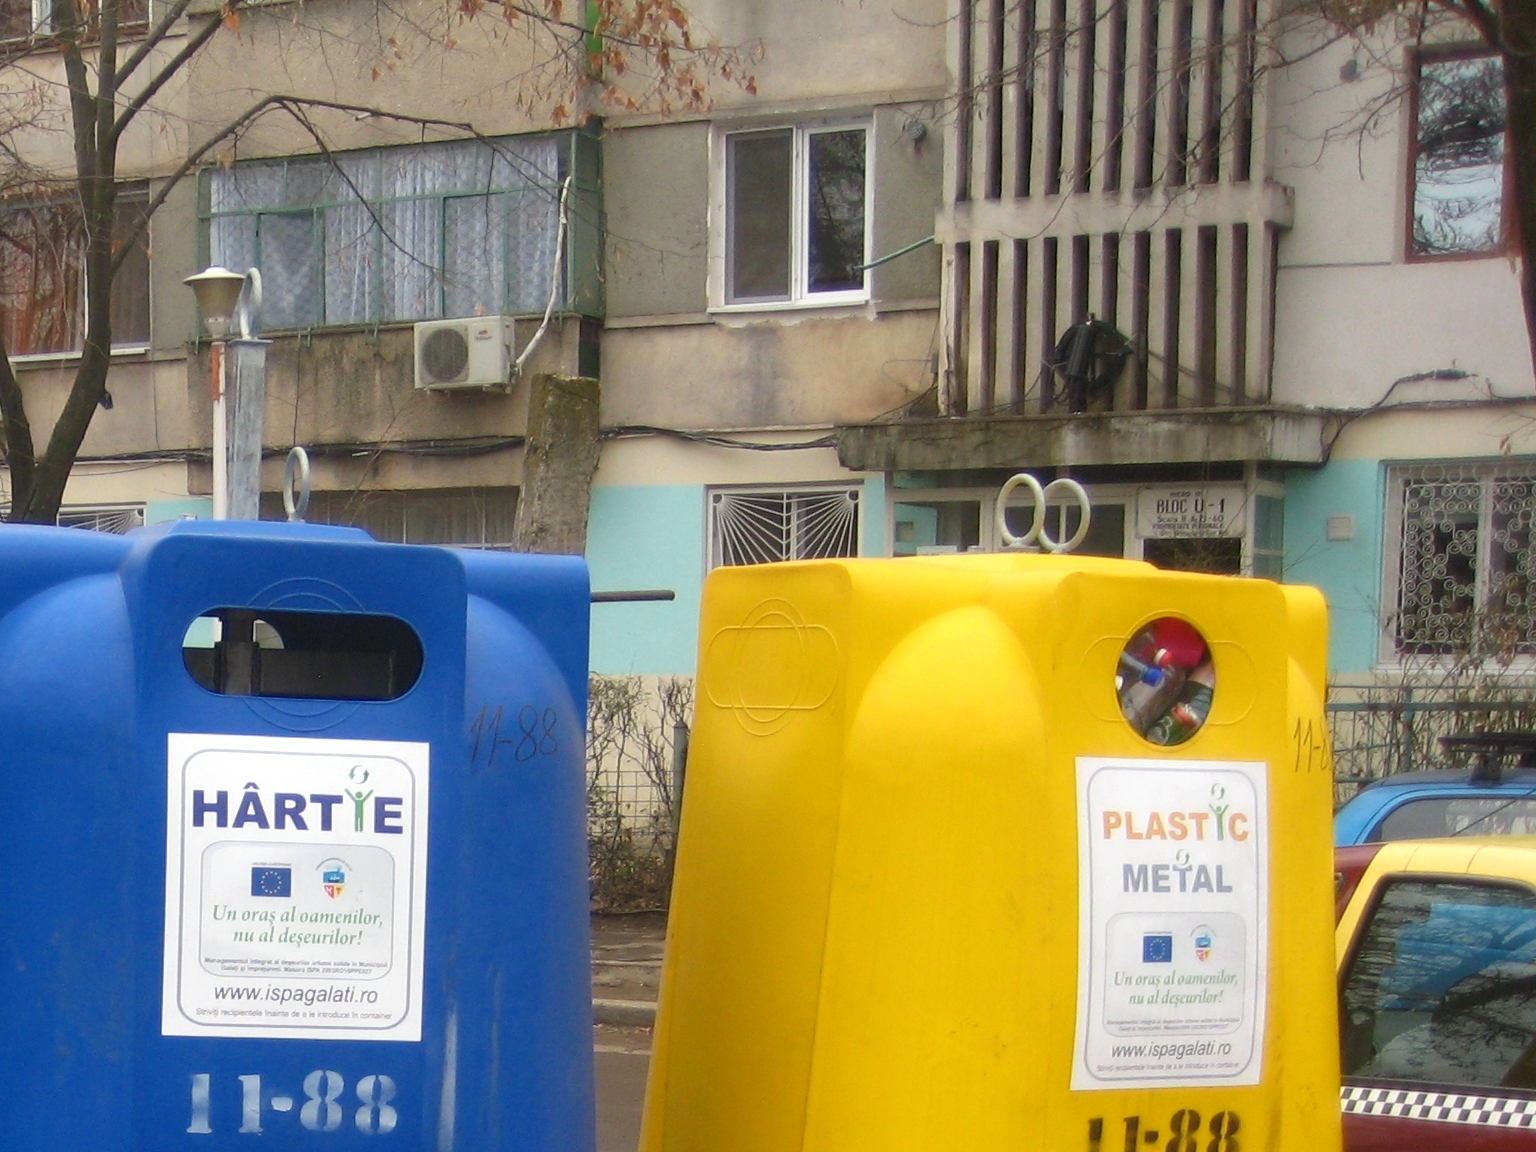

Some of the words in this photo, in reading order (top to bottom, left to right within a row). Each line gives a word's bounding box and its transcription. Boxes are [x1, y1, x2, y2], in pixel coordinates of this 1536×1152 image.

[1156, 499, 1187, 514] BLOC
[470, 705, 558, 766] 11-88
[192, 782, 404, 834] HÂRTIE
[1102, 804, 1249, 841] PLASTIC
[1122, 863, 1233, 893] METAL
[212, 904, 237, 921] Un
[241, 908, 276, 926] oraş
[280, 905, 296, 922] al
[299, 908, 383, 928] oamenilor,
[233, 930, 254, 942] nu
[258, 926, 274, 942] al
[278, 926, 363, 948] deşeurilor!
[1114, 971, 1132, 986] Un
[1164, 970, 1176, 985] al
[1178, 970, 1239, 986] oamenilor,
[214, 984, 378, 1006] www.ispagalati.ro
[1128, 994, 1145, 1005] nu
[1147, 989, 1159, 1005] al
[1161, 989, 1224, 1007] deşeurilor!
[1111, 1040, 1232, 1060] www.ispagalati.ro
[185, 1069, 398, 1136] 11-88
